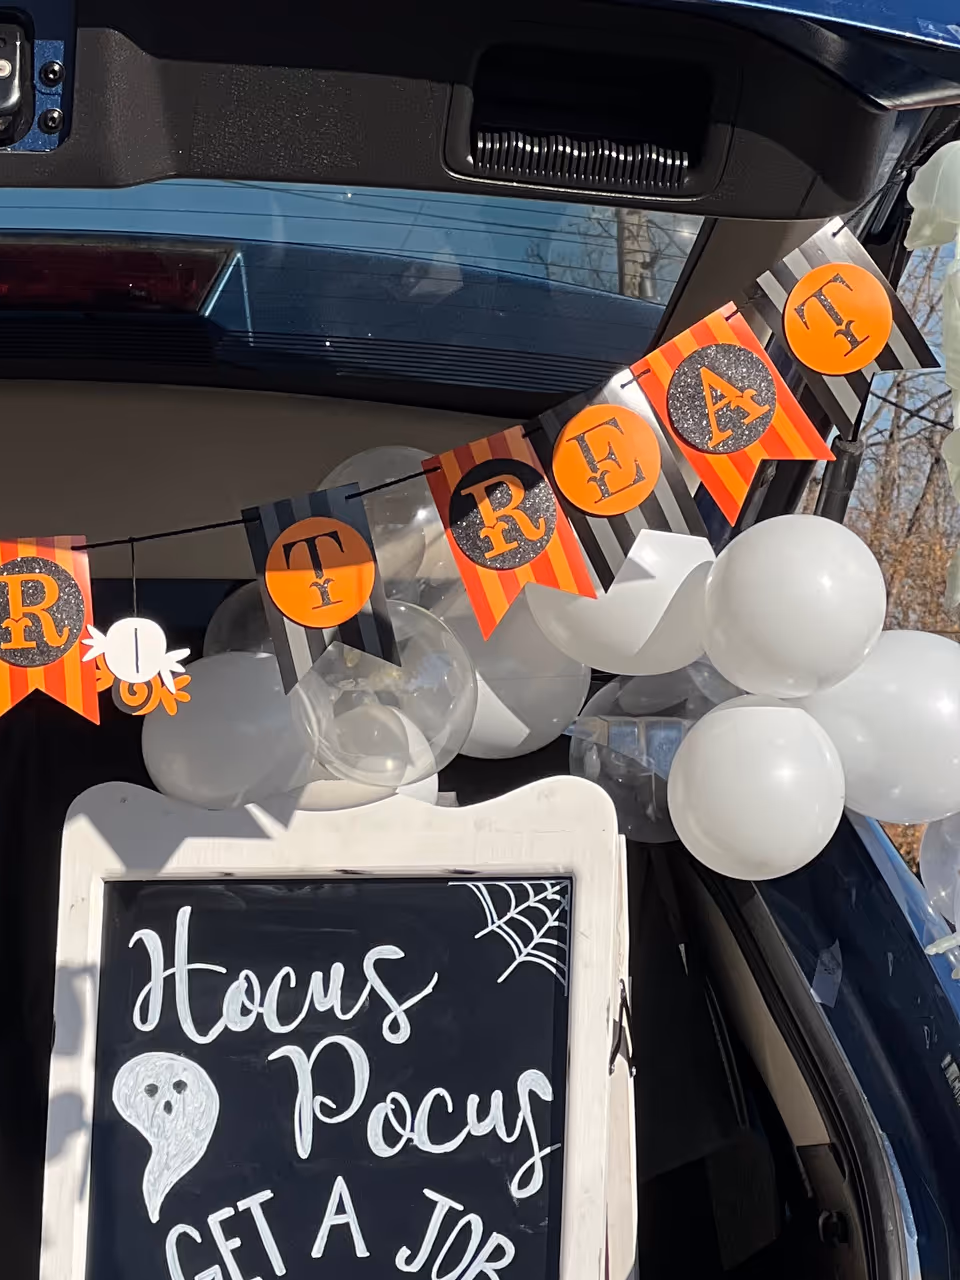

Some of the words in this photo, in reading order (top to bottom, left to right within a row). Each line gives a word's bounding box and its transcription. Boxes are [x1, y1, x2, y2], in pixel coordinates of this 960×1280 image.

[284, 273, 871, 610] TREAT
[129, 906, 438, 1044] Hocus
[267, 1035, 561, 1199] Pocus
[311, 1175, 370, 1259] A
